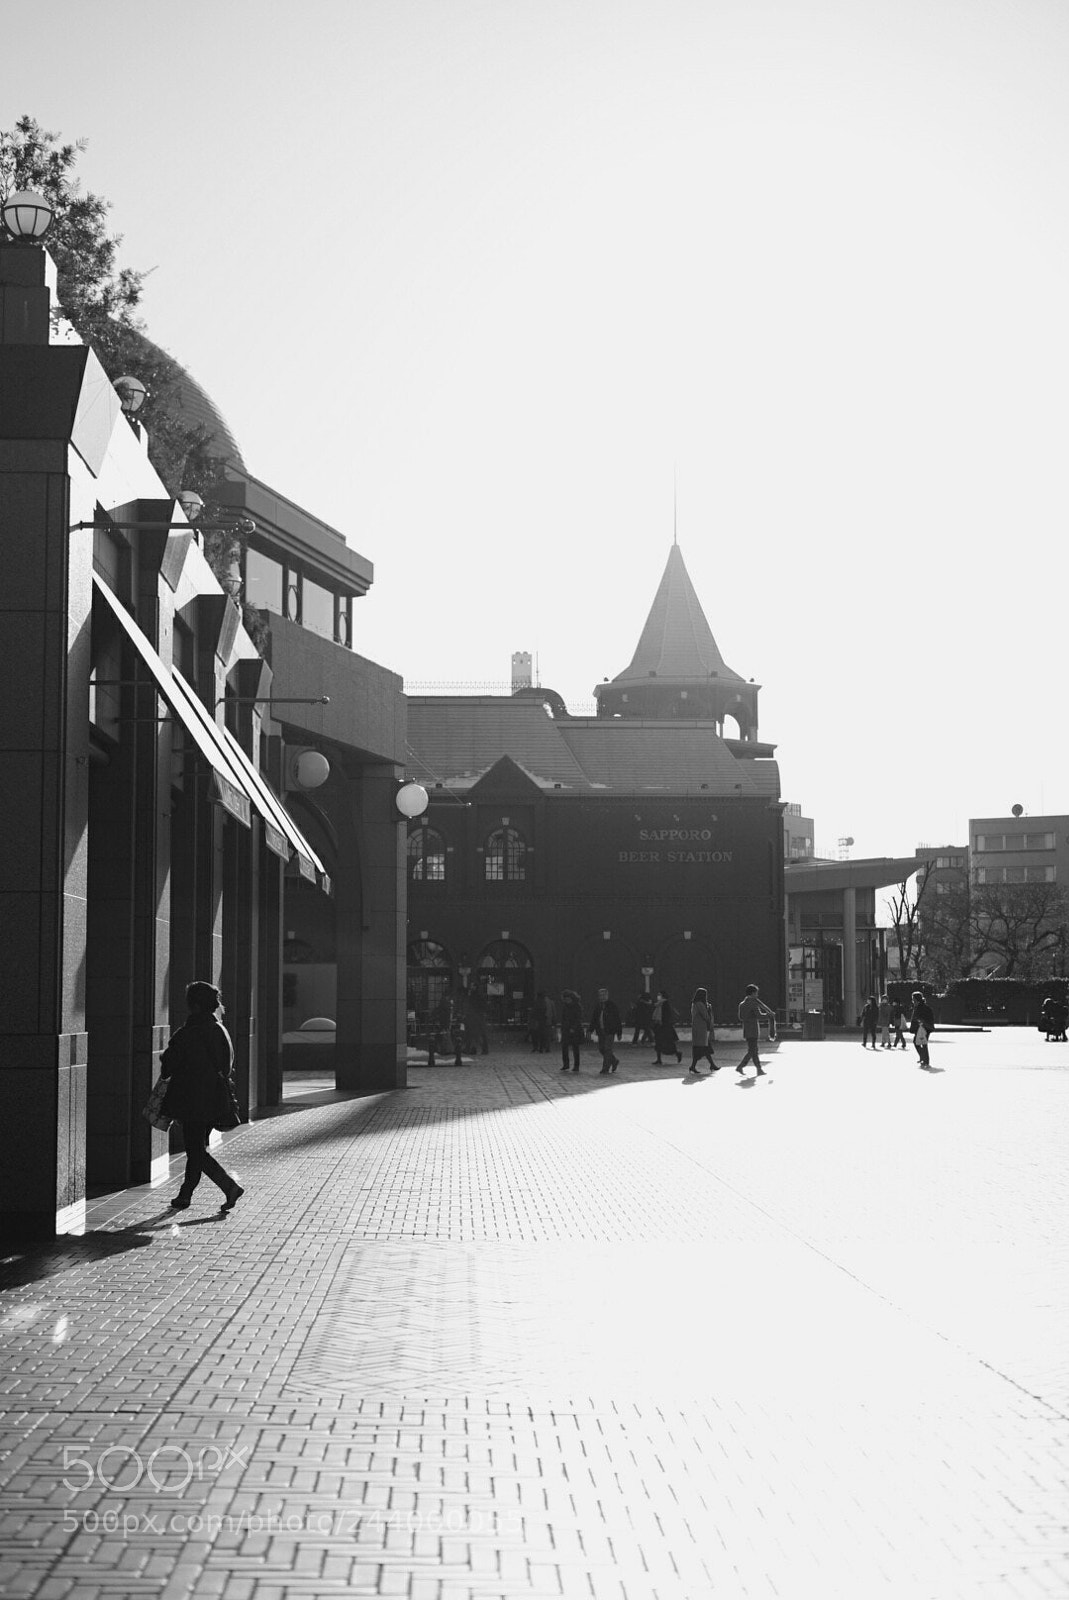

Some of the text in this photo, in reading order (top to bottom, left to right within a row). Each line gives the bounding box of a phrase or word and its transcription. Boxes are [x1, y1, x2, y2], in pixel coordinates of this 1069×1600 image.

[640, 829, 711, 841] SAPPORO
[618, 851, 733, 862] BEER STATION
